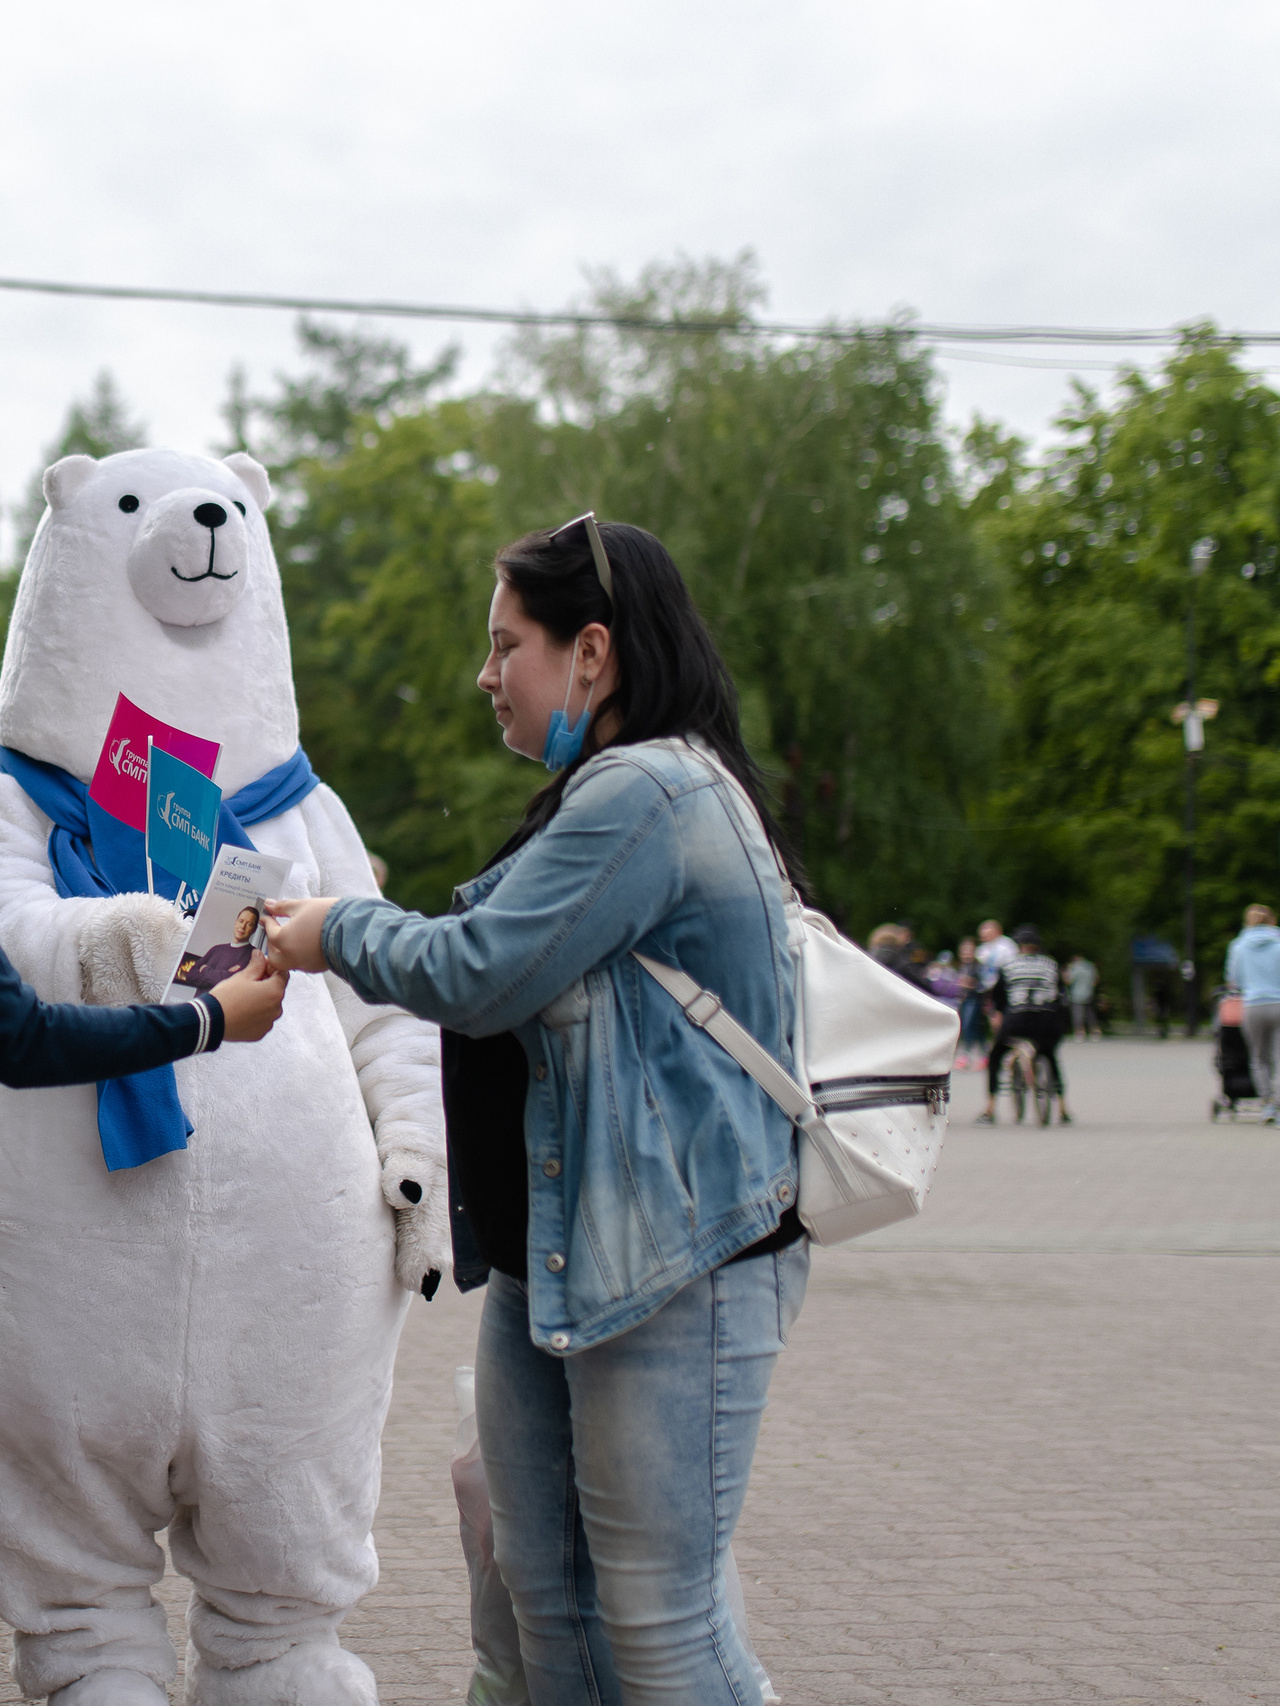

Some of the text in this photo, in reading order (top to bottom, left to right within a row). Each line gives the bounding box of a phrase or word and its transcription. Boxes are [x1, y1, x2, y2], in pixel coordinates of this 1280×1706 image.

[121, 759, 148, 784] СМП
[172, 802, 191, 819] группа
[171, 812, 210, 852] СМП БАНК
[248, 862, 261, 871] БАНК
[220, 870, 251, 883] КРЕДИТЫ
